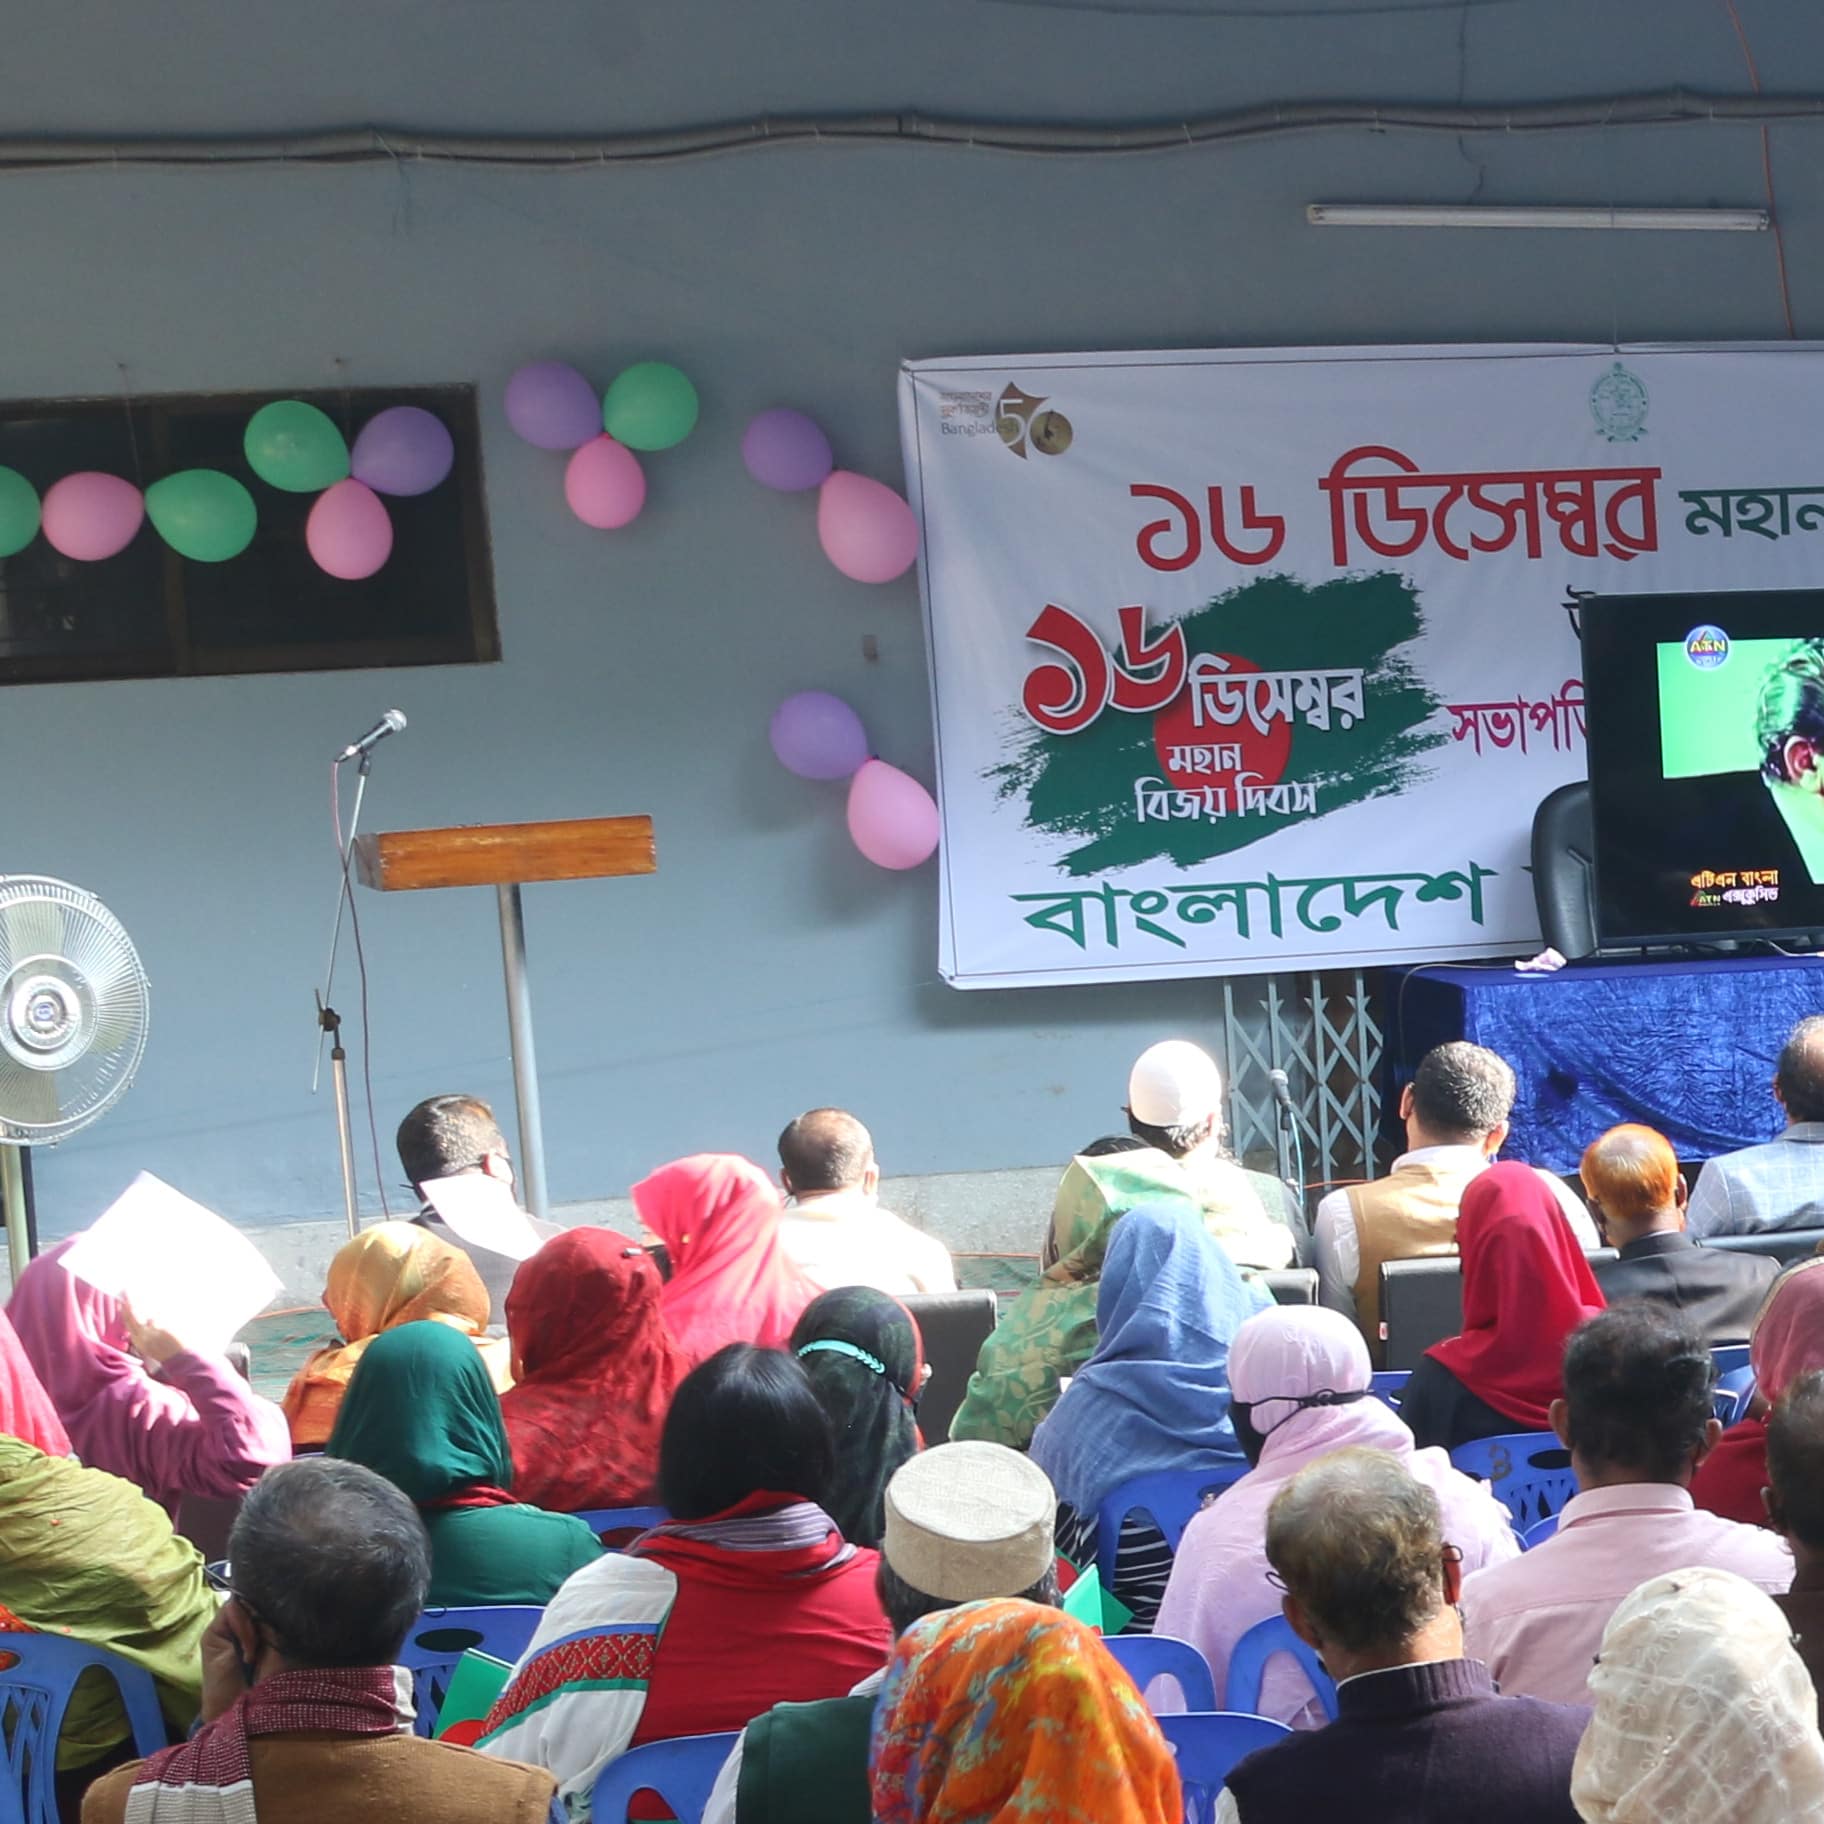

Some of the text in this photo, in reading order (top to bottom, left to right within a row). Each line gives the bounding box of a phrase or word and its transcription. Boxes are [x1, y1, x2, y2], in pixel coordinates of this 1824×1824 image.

[1130, 483, 1287, 572] ১৬
[1318, 445, 1662, 566] ডিসেম্বর
[1022, 602, 1188, 736] ১৬
[1188, 652, 1367, 736] ডিসেম্বর
[1134, 771, 1318, 825] বিজয় দিবস
[1166, 743, 1243, 775] মহান
[1008, 861, 1499, 950] বাংলাদেশ
[1740, 869, 1779, 887] বাংলা
